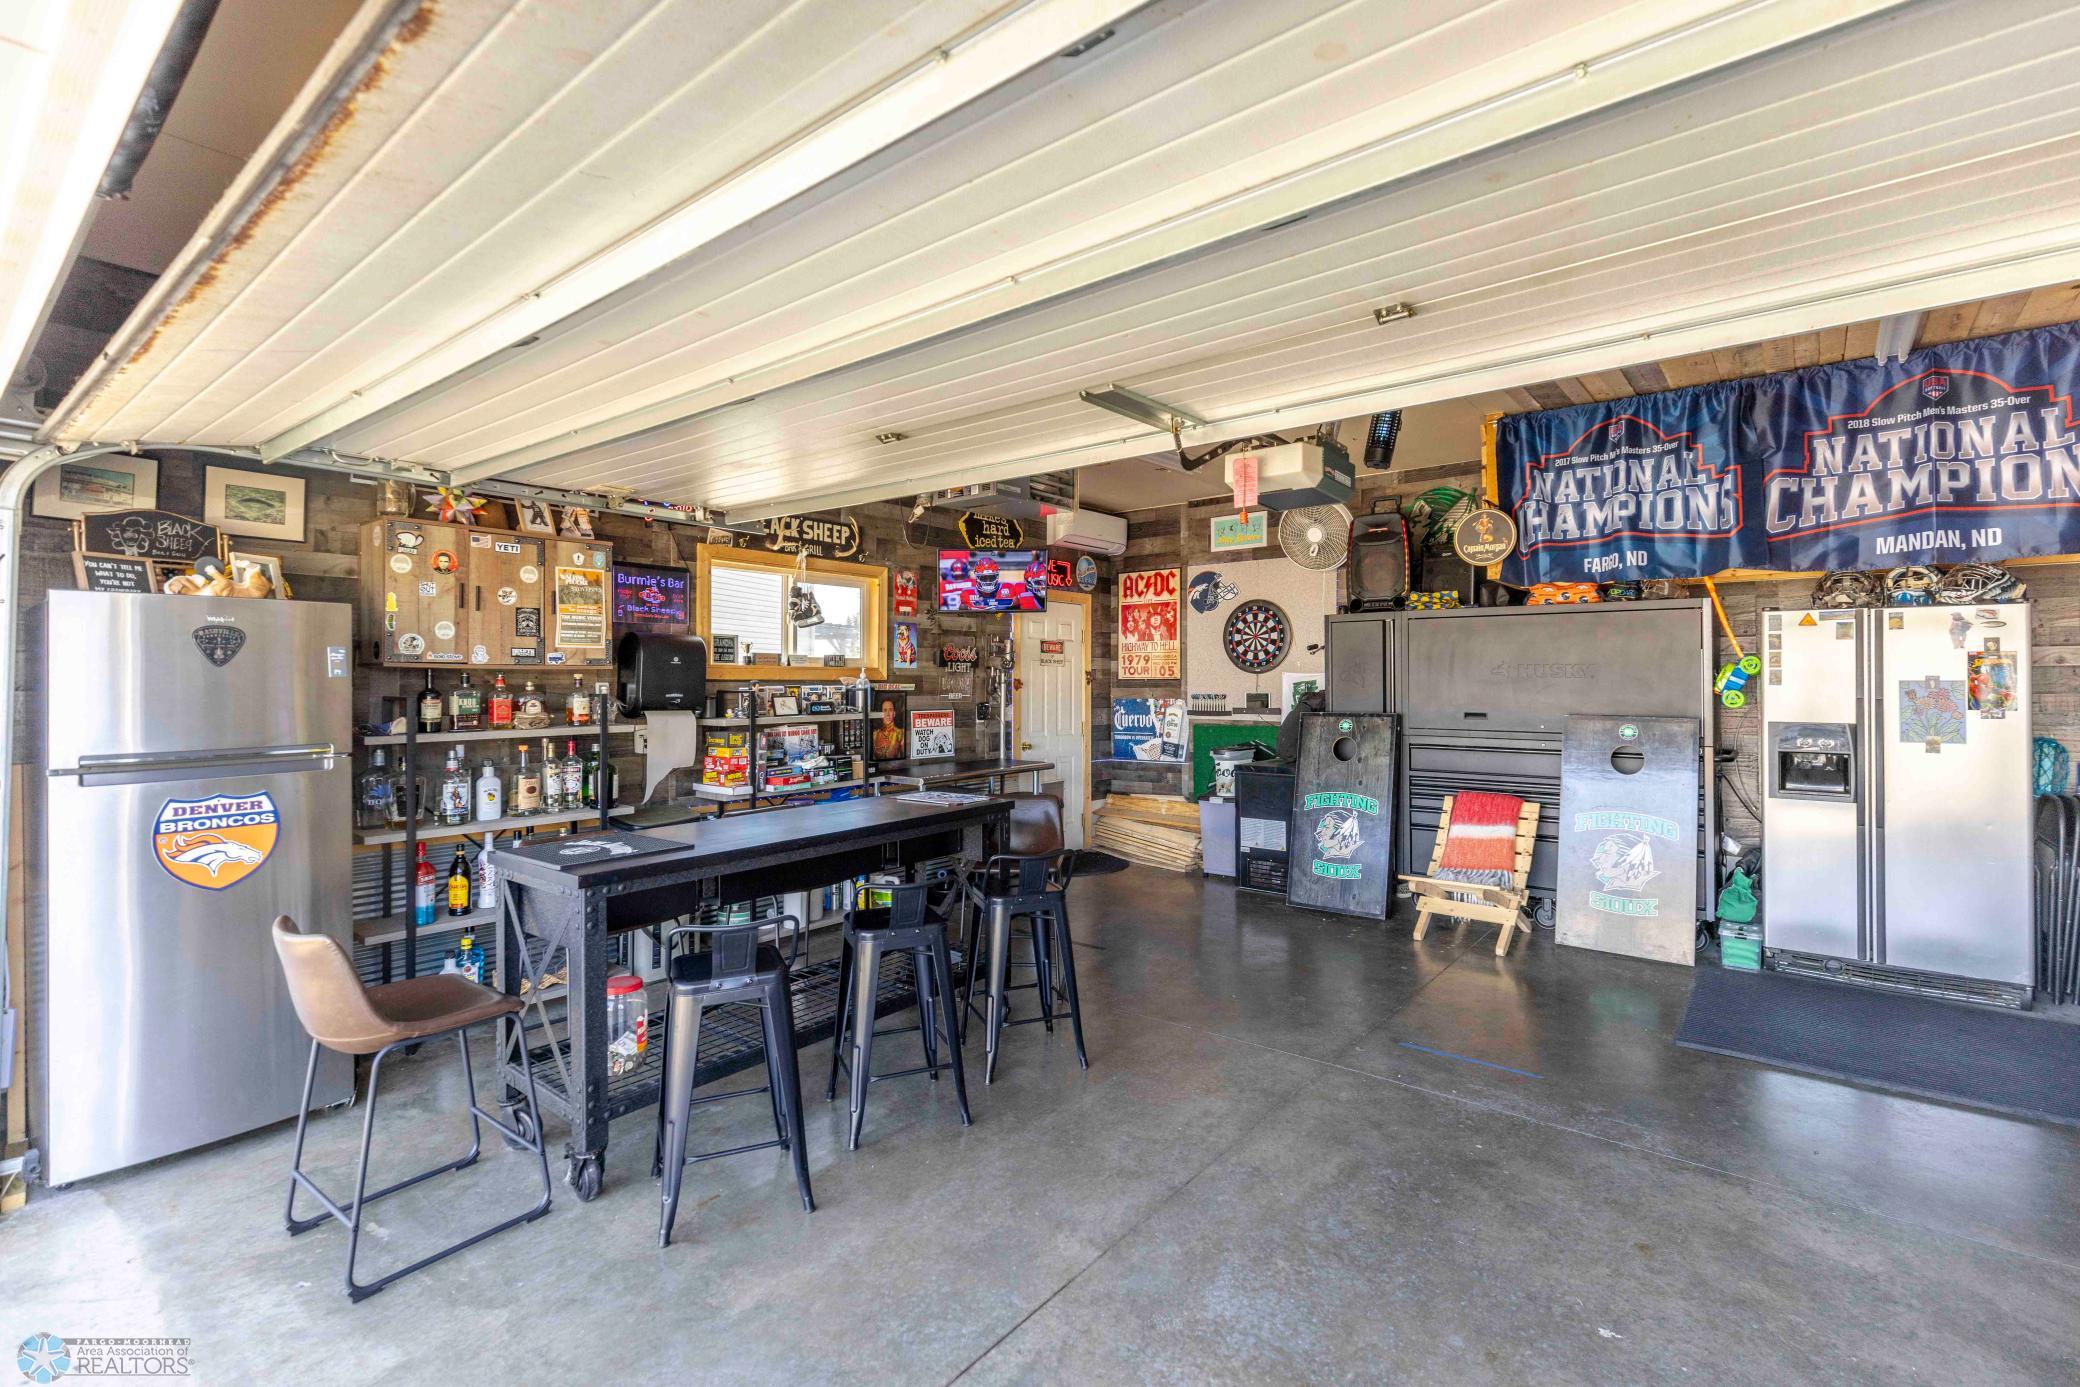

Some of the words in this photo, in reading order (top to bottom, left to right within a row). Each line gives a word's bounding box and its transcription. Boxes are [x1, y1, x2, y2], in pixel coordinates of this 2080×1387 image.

[1847, 418, 1870, 430] 2018
[1871, 415, 1895, 428] Slow
[1897, 411, 1922, 424] Pitch
[1923, 405, 1945, 418] Men's
[1946, 402, 1988, 416] Masters
[1990, 394, 2031, 409] 35-Over
[1812, 407, 2076, 477] NATIONAL
[1554, 456, 1570, 467] 2017
[1571, 455, 1589, 464] Slow
[1590, 452, 1608, 462] Pitch
[1621, 445, 1651, 455] Masters
[1652, 440, 1679, 453] 35-Over
[1765, 448, 2080, 534] CHAMPION
[156, 520, 203, 541] BLACK
[763, 517, 800, 538] ACK
[802, 520, 851, 545] SHEEP
[982, 520, 1010, 536] hard
[496, 543, 519, 553] YETI
[975, 535, 998, 548] iced
[998, 536, 1016, 549] tea
[1463, 543, 1485, 554] Captain
[1485, 542, 1507, 552] Morgan
[1875, 529, 1967, 555] MANDAN,
[1970, 527, 2002, 547] ND
[84, 559, 98, 568] YOU
[99, 561, 118, 570] CAN'T
[120, 563, 133, 571] TELL
[1583, 555, 1624, 574] FARGO,
[1626, 550, 1648, 567] ND
[667, 577, 685, 589] Bar
[1047, 573, 1065, 587] USIC
[626, 604, 649, 612] Black
[943, 644, 977, 661] Coors
[1043, 643, 1063, 651] BEWARE
[1121, 641, 1149, 653] HIGHWAY
[1151, 641, 1159, 652] TO
[1159, 640, 1177, 652] HELL
[947, 662, 972, 673] LIGHT
[1121, 654, 1151, 666] 1979
[1121, 665, 1150, 676] TOUR
[1158, 665, 1175, 677] 05
[1517, 663, 1592, 680] HUSKY
[914, 718, 953, 728] BEWARE
[1114, 707, 1153, 730] Cuervo
[916, 748, 932, 756] DUTY
[172, 800, 264, 818] DENVER
[1304, 792, 1379, 815] FIGHTING
[159, 813, 276, 834] BRONCOS
[1574, 811, 1679, 840] FIGHTING
[1312, 859, 1362, 879] SIOUX
[1589, 891, 1659, 916] SIOUX
